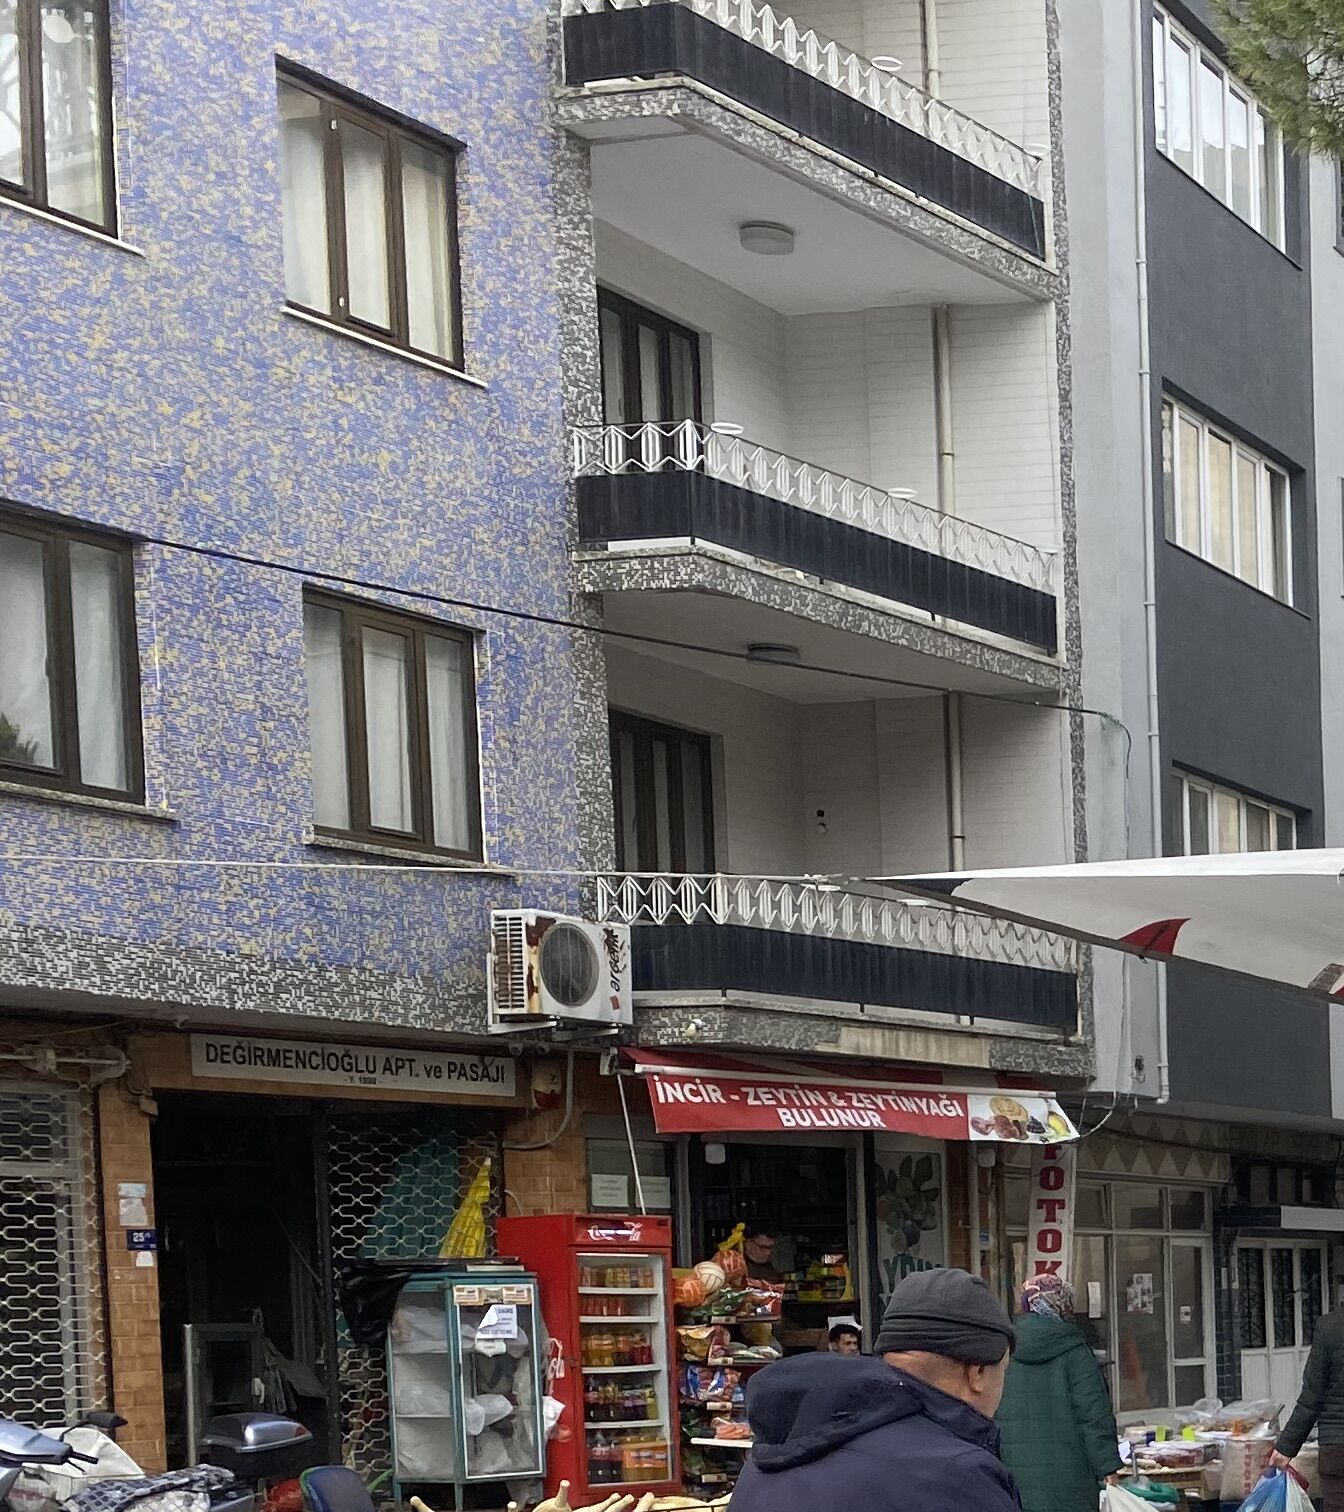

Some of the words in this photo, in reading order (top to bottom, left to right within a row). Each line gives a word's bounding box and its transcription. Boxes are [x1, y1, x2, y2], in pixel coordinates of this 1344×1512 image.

[205, 1039, 377, 1074] DEĞİRMENCİOĞLU
[382, 1057, 419, 1078] APT.
[424, 1063, 442, 1079] ve
[653, 1075, 727, 1104] İNCİR
[741, 1084, 825, 1107] ZEYTİN
[829, 1092, 847, 1106] &
[847, 1089, 965, 1118] ZEYTİNYAĞI
[776, 1107, 886, 1128] BULUNUR
